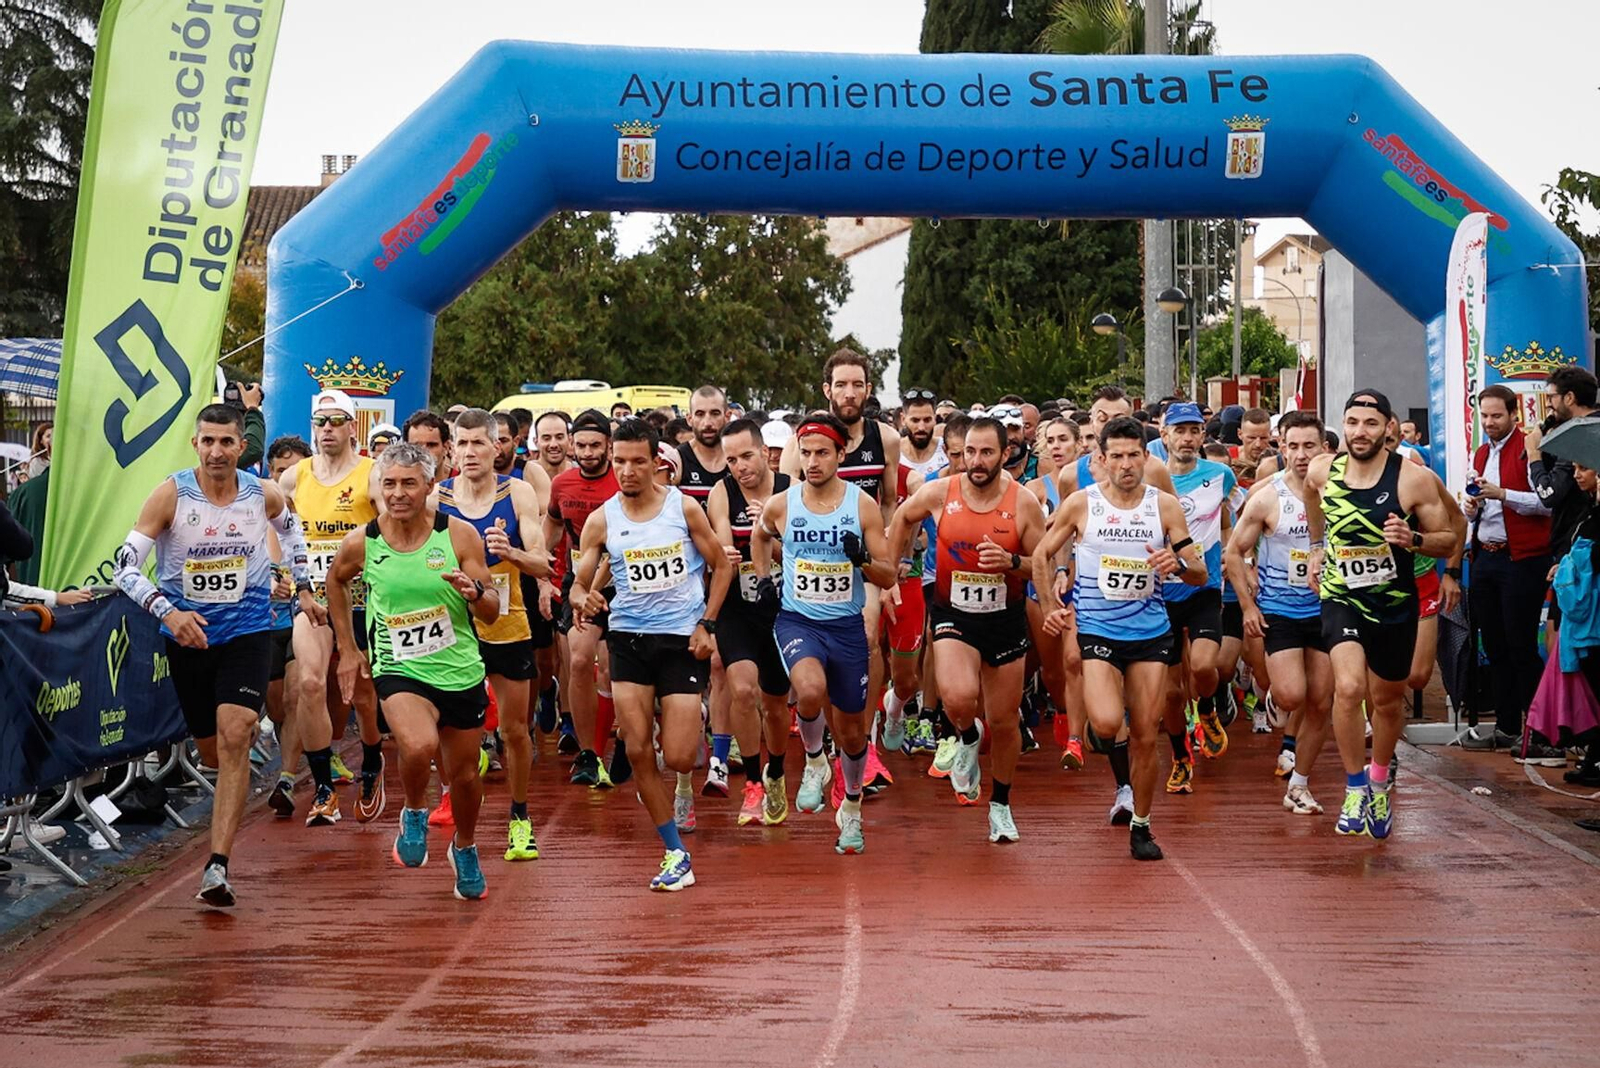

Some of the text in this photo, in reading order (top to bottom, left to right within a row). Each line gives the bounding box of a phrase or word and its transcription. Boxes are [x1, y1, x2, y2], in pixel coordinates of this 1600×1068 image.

[617, 69, 1270, 119] Ayuntamiento de Santa Fe
[189, 0, 265, 292] de Granad
[676, 136, 1209, 179] Concejalía de Deporte y Salud
[1096, 527, 1154, 539] MARACENA
[187, 545, 255, 557] MARACENA
[632, 549, 674, 559] 38 FONDO
[629, 556, 685, 582] 3013
[1338, 556, 1394, 578] 1054
[192, 572, 238, 592] 995
[796, 574, 850, 593] 3133
[1106, 571, 1148, 590] 575
[960, 586, 997, 602] 111
[397, 621, 444, 647] 274
[36, 675, 82, 722] Deportes
